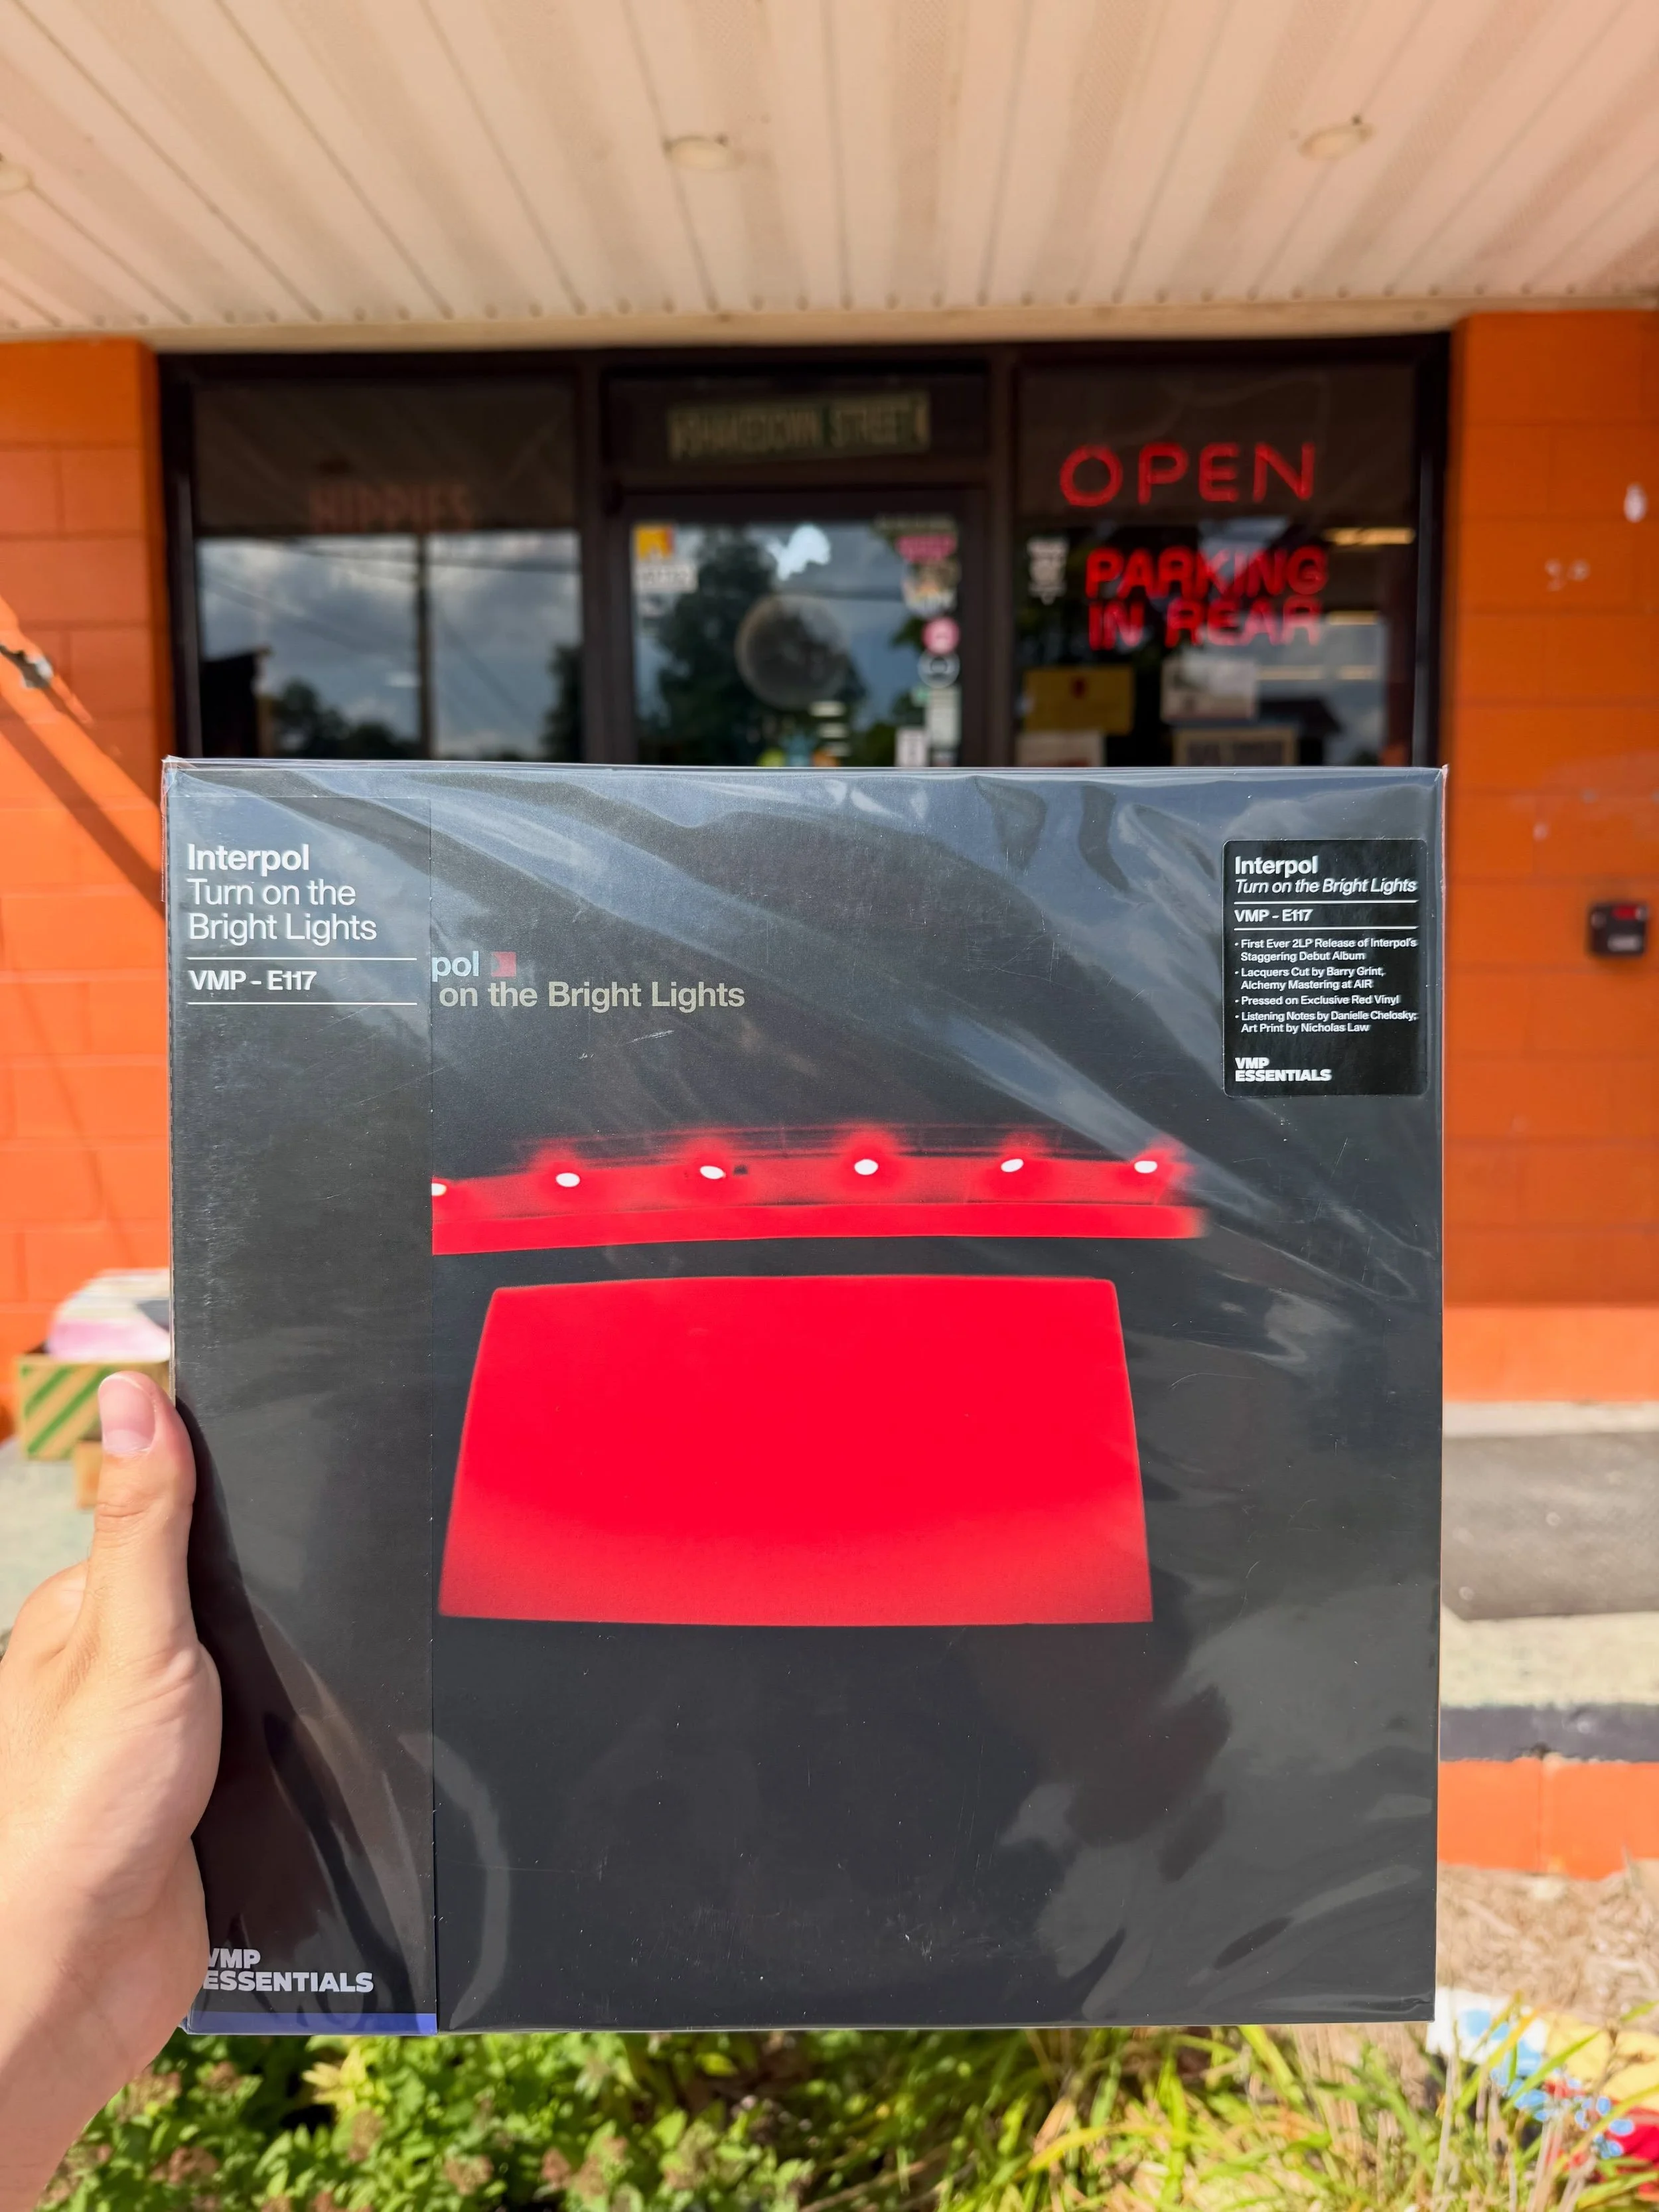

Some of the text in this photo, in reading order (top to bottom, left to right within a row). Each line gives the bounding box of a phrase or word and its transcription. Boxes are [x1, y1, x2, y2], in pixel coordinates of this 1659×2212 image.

[830, 399, 910, 447] STREET
[1059, 442, 1316, 507] OPEN
[1085, 546, 1329, 599] PARKING
[1088, 595, 1321, 651] IN REAR
[187, 844, 309, 877] Interpol
[1236, 855, 1319, 878] Interpol
[187, 878, 356, 905] Turn on the
[1236, 877, 1418, 896] Turn on the Bright Lights
[1234, 909, 1269, 922] VMP
[1282, 909, 1313, 921] E117
[188, 913, 377, 946] Bright Lights
[1242, 938, 1419, 949] First Ever 2LP Release of Interpol's
[1241, 952, 1297, 962] Staggering
[1299, 952, 1331, 960] Debut
[188, 970, 246, 990] VMP
[267, 970, 317, 990] E117
[1242, 966, 1386, 978] Lacquers Cut by Barry Grint,
[1241, 980, 1286, 991] Alchemy
[1288, 980, 1340, 991] Mastering
[1353, 980, 1374, 988] AIR
[439, 982, 745, 1013] on the Bright Lights
[1242, 996, 1283, 1005] Pressed
[1301, 995, 1350, 1004] Exclusive
[1352, 995, 1374, 1003] Red
[1374, 994, 1401, 1005] Vinyl
[1242, 1012, 1285, 1023] Listening
[1287, 1011, 1315, 1021] Notes
[1317, 1011, 1330, 1022] by
[1331, 1011, 1370, 1019] Danielle
[1241, 1023, 1371, 1034] Art Print by Nicholas Law
[1235, 1057, 1269, 1069] VMP
[1236, 1069, 1332, 1082] ESSENTIALS
[203, 1970, 374, 1993] ESSENTIALS
